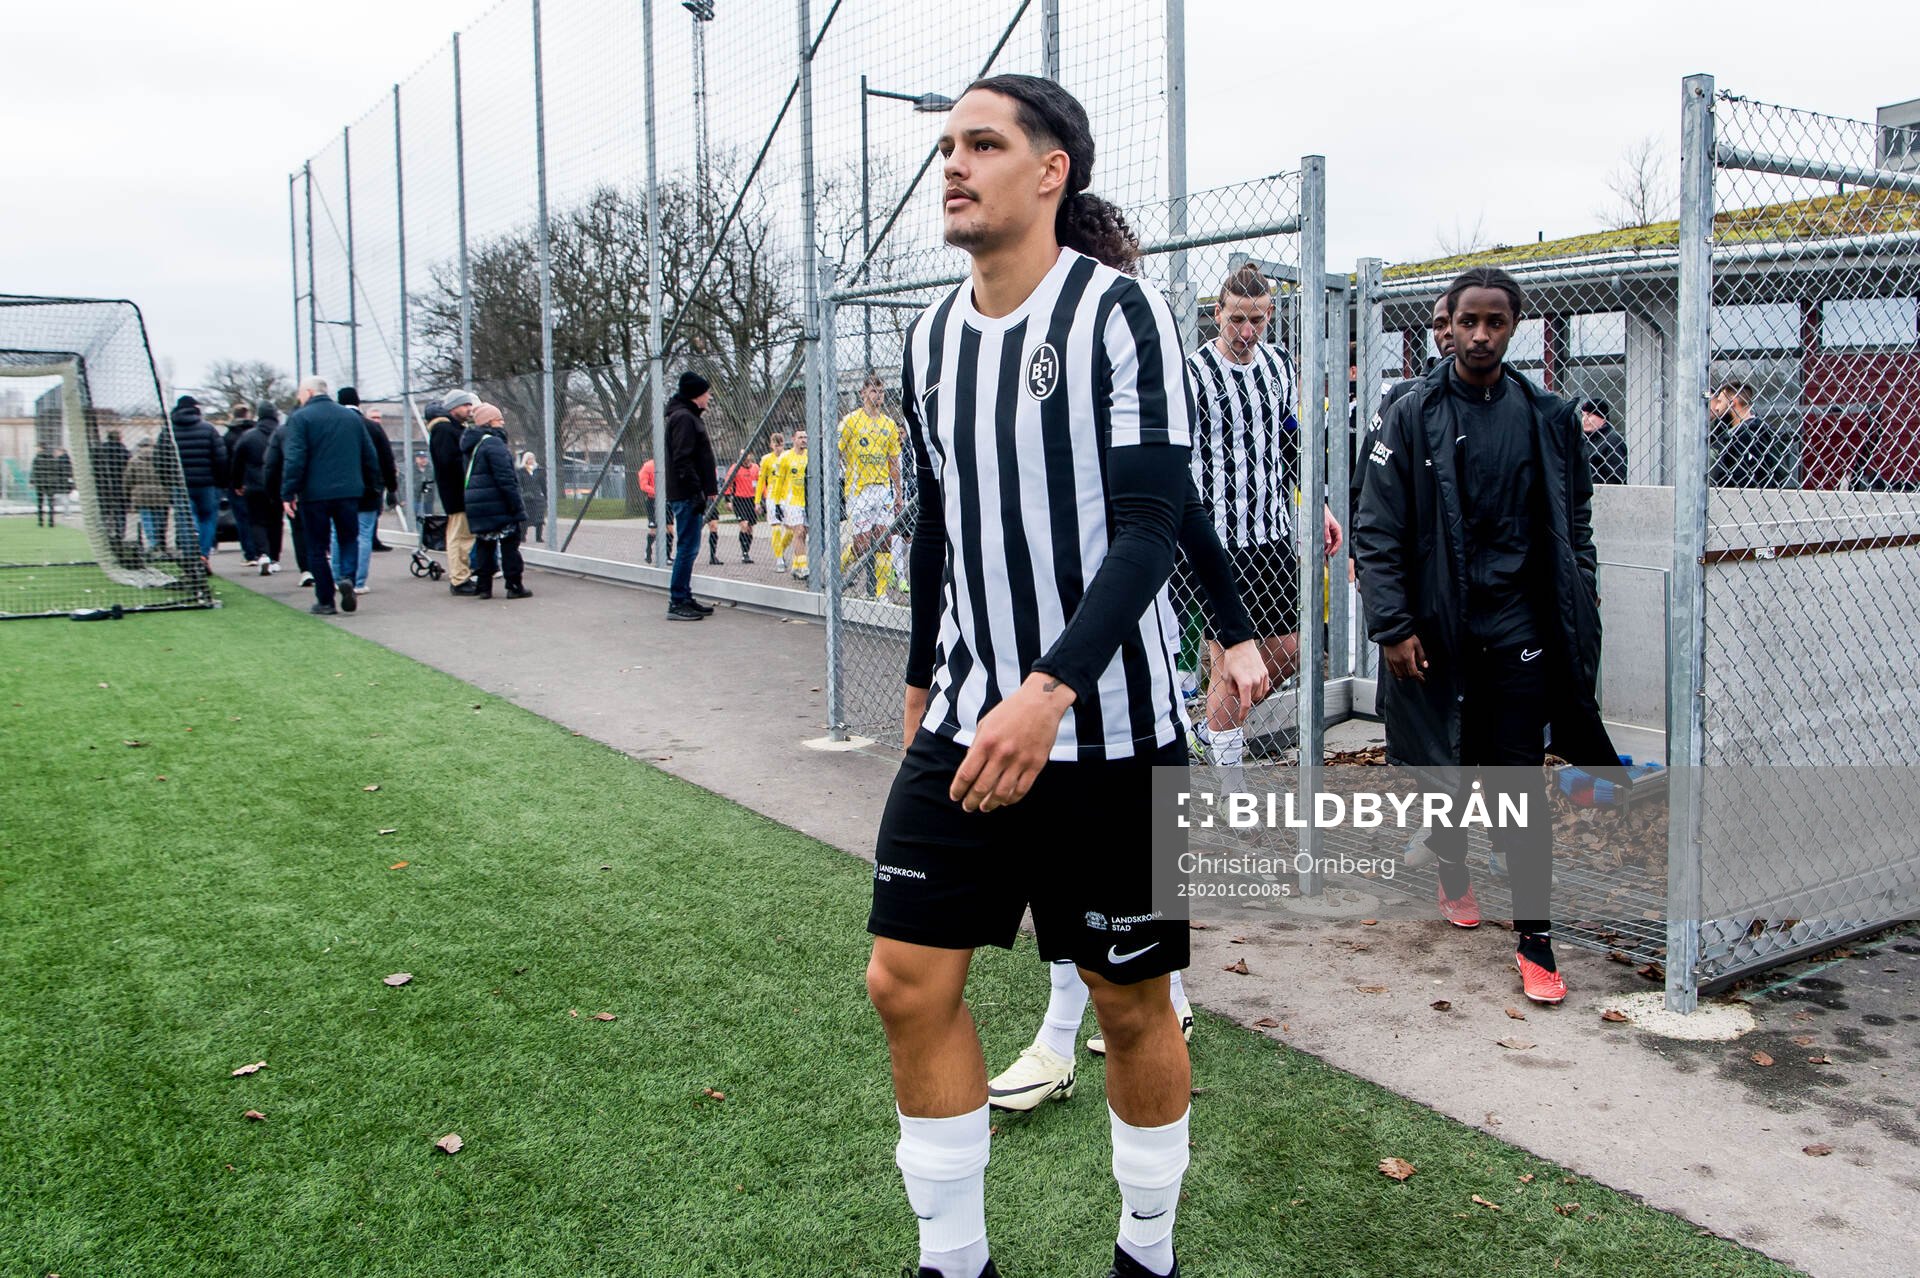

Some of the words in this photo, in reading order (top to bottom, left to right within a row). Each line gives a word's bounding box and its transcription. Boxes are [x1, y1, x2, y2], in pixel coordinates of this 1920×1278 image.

[879, 864, 927, 880] LANDSKRONA
[1111, 910, 1163, 924] LANDSKRONA
[1111, 924, 1132, 932] STAD
